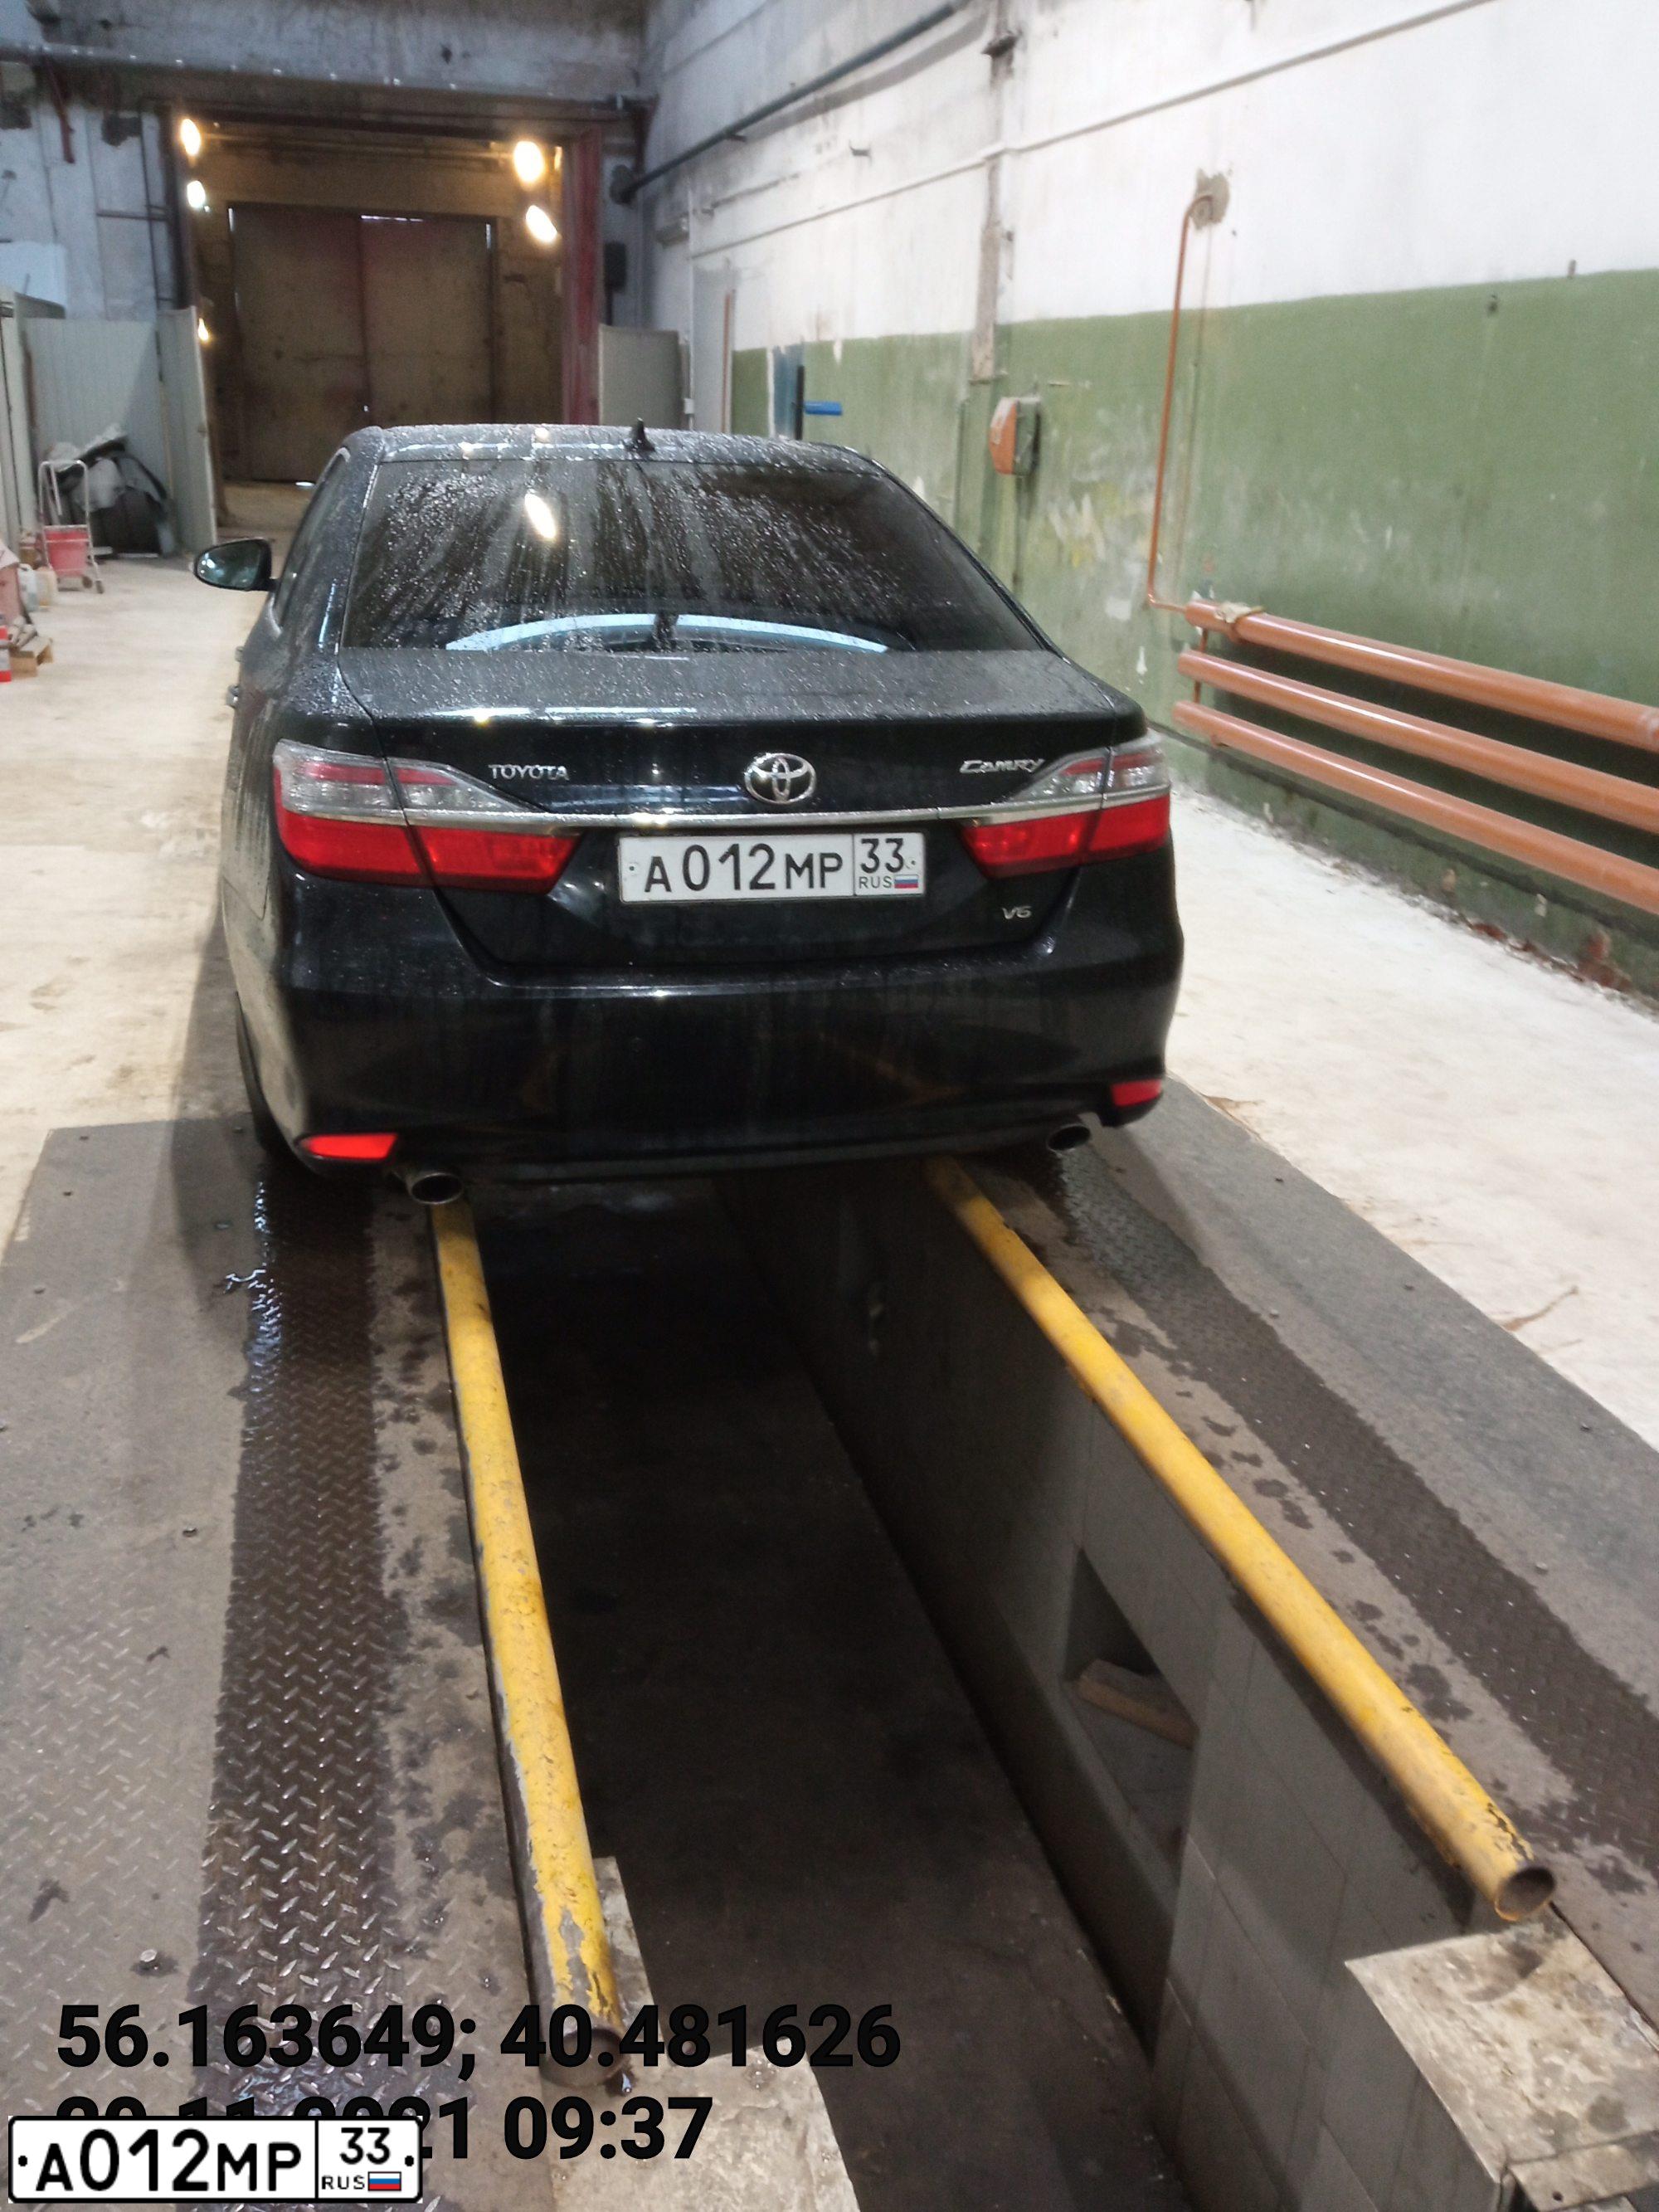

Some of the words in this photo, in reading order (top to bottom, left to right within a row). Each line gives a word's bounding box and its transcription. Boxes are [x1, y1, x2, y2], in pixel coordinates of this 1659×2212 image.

[488, 764, 570, 780] TOYOTA
[860, 837, 904, 874] 33
[859, 875, 893, 889] RUS
[1002, 905, 1032, 919] V6
